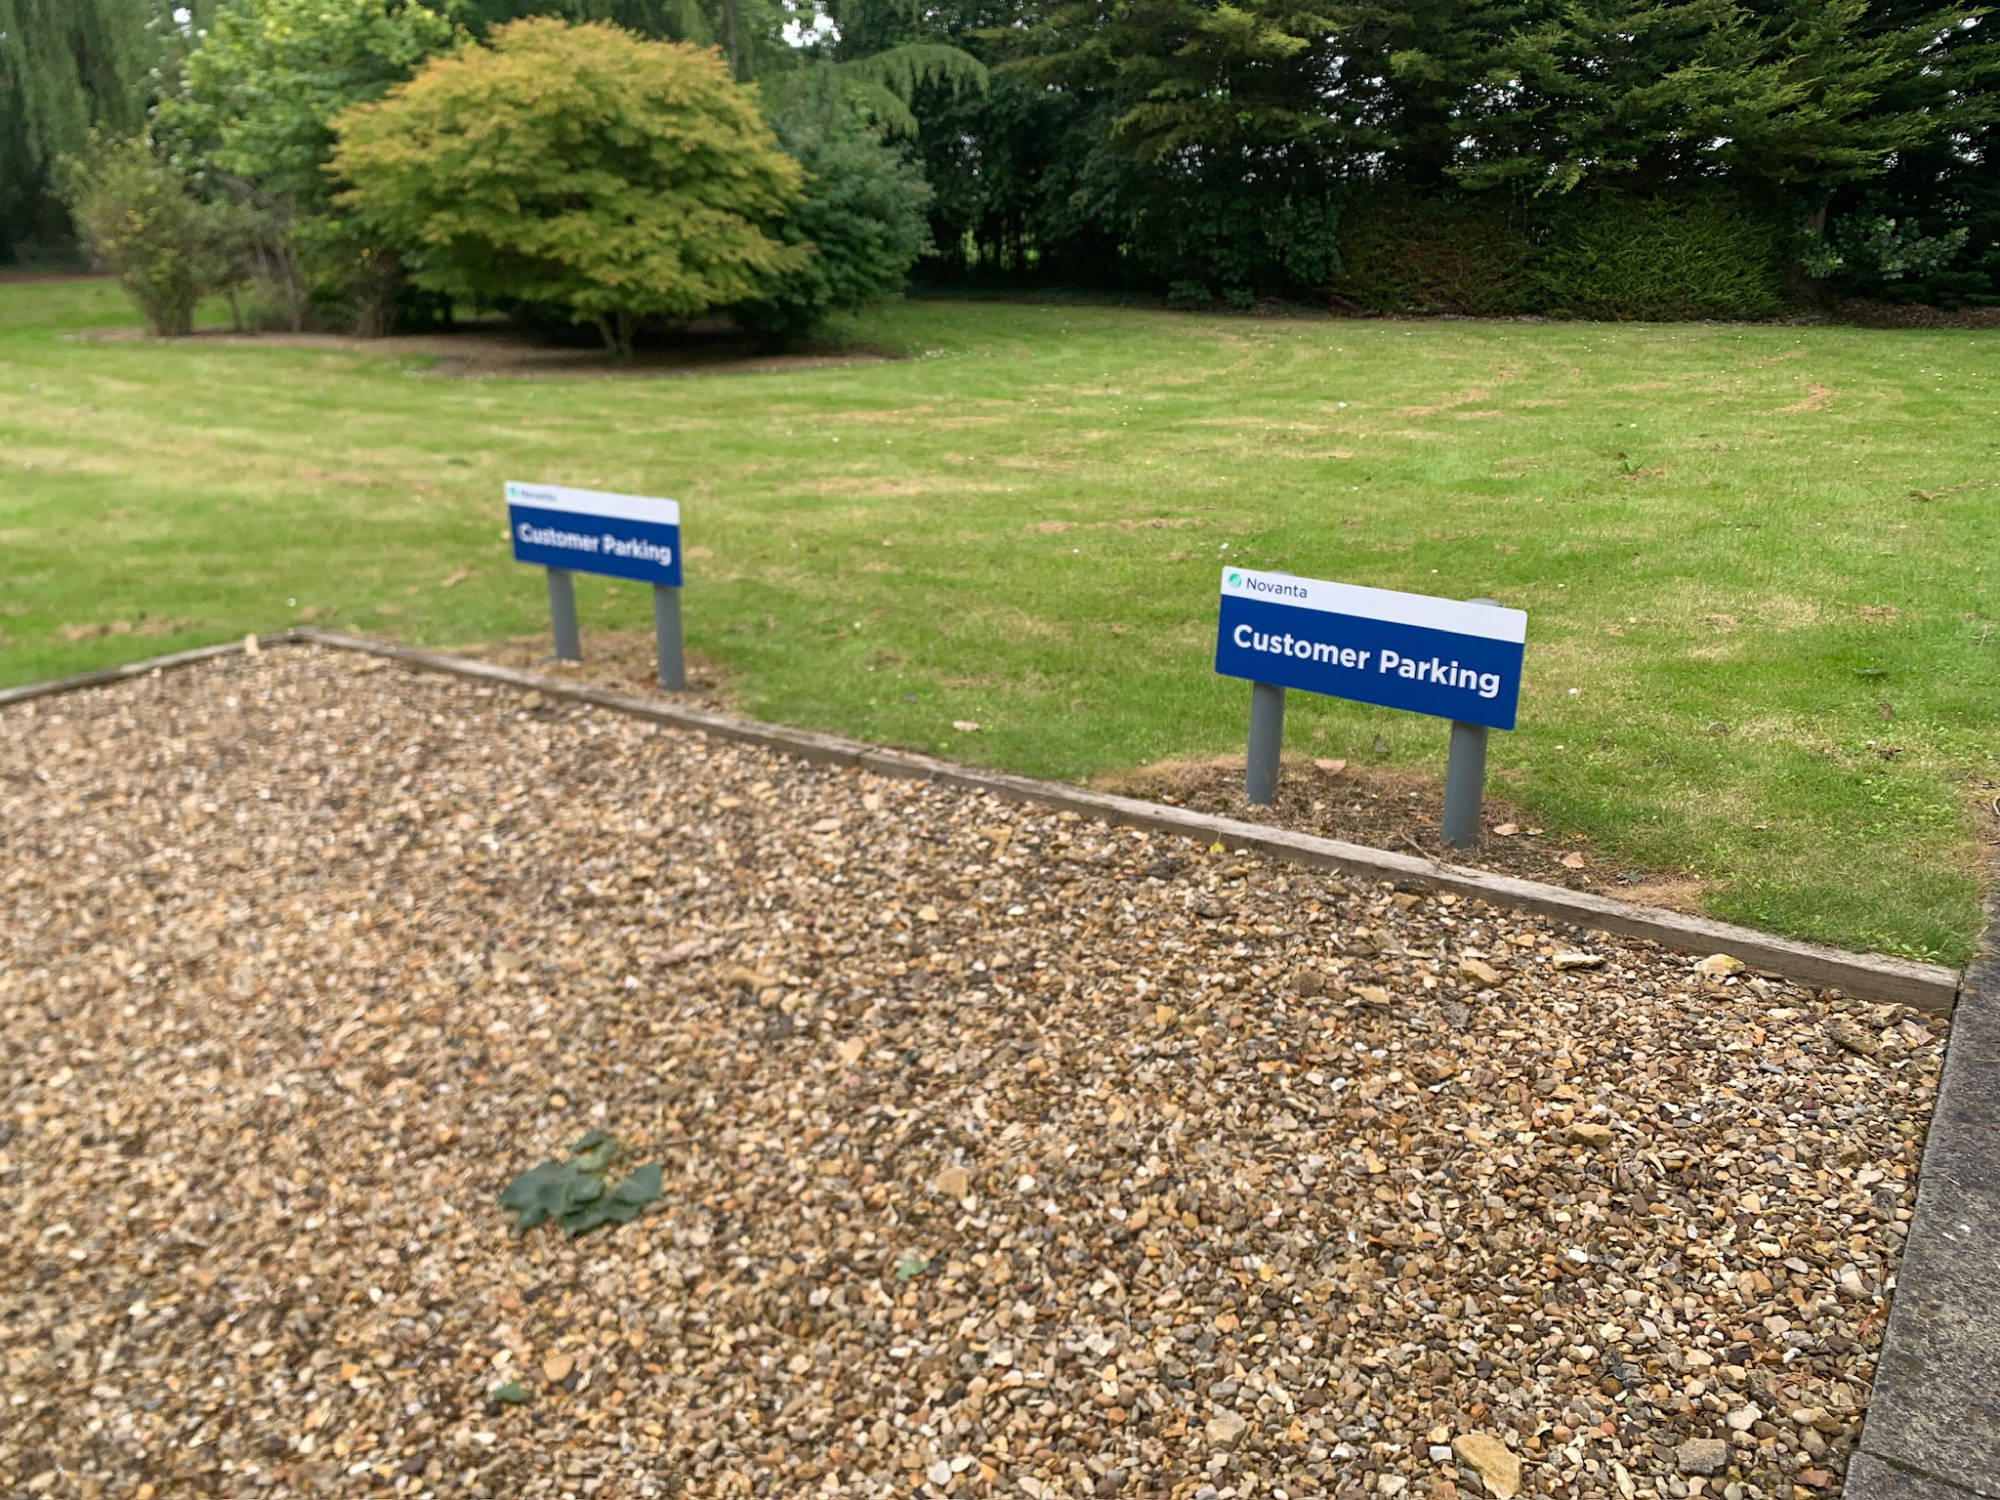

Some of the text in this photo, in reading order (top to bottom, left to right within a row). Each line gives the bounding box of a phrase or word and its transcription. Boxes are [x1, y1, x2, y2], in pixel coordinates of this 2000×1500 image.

[518, 522, 672, 566] Customer Parking
[1246, 577, 1308, 599] Novanta
[1233, 624, 1501, 699] Customer Parking
